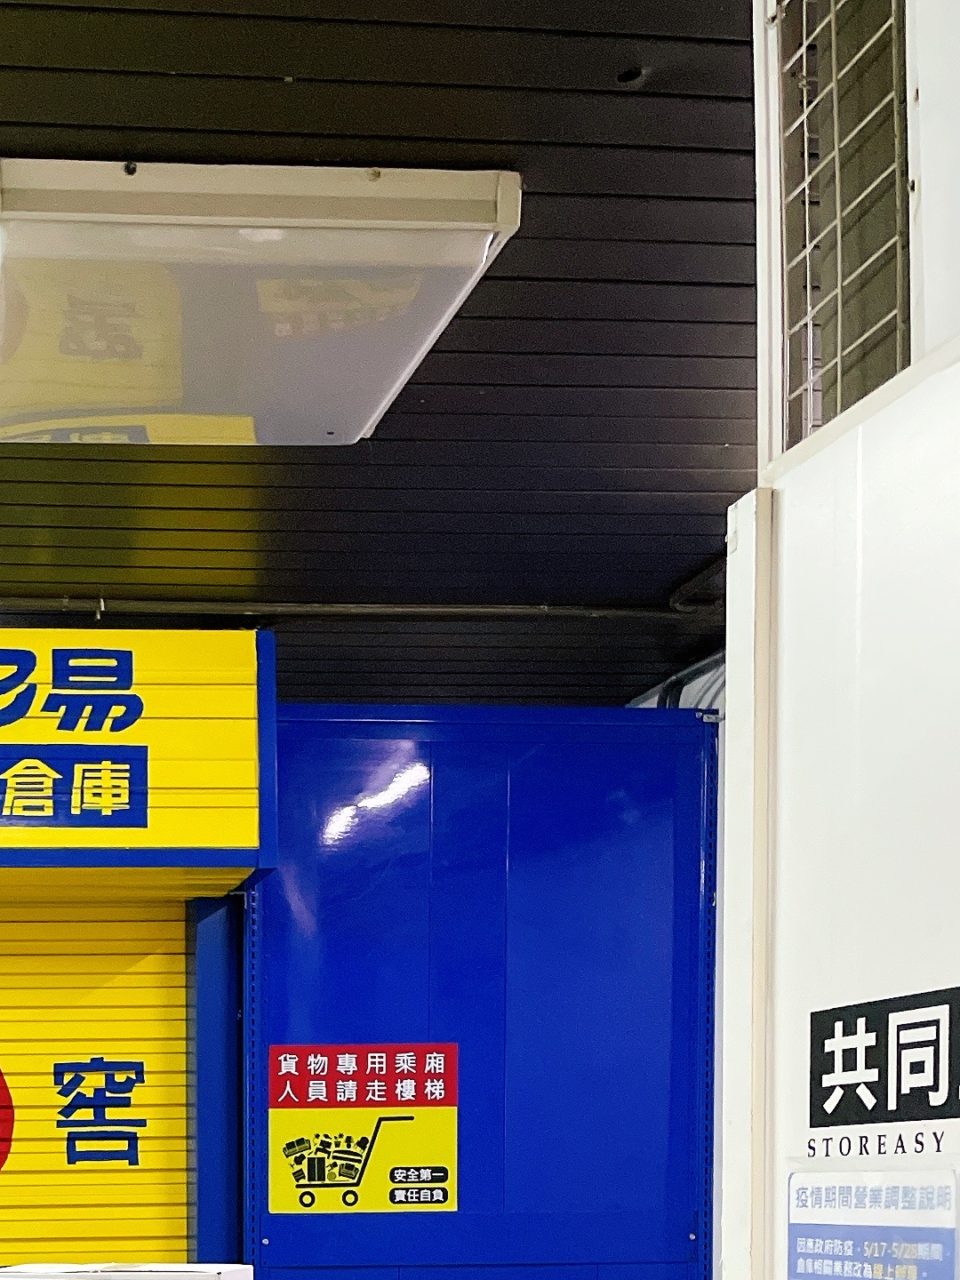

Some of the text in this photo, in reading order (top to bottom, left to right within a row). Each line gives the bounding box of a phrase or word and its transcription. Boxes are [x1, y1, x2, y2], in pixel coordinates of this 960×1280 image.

[277, 1051, 446, 1077] 貨物專用乘廂
[821, 1003, 960, 1115] 共同
[277, 1079, 446, 1103] 人員請走樓梯
[807, 1130, 945, 1158] STOREASY
[393, 1168, 445, 1183] 安全第一
[393, 1188, 445, 1203] 責任自負
[795, 1185, 952, 1211] 疫情期間營業調整說明
